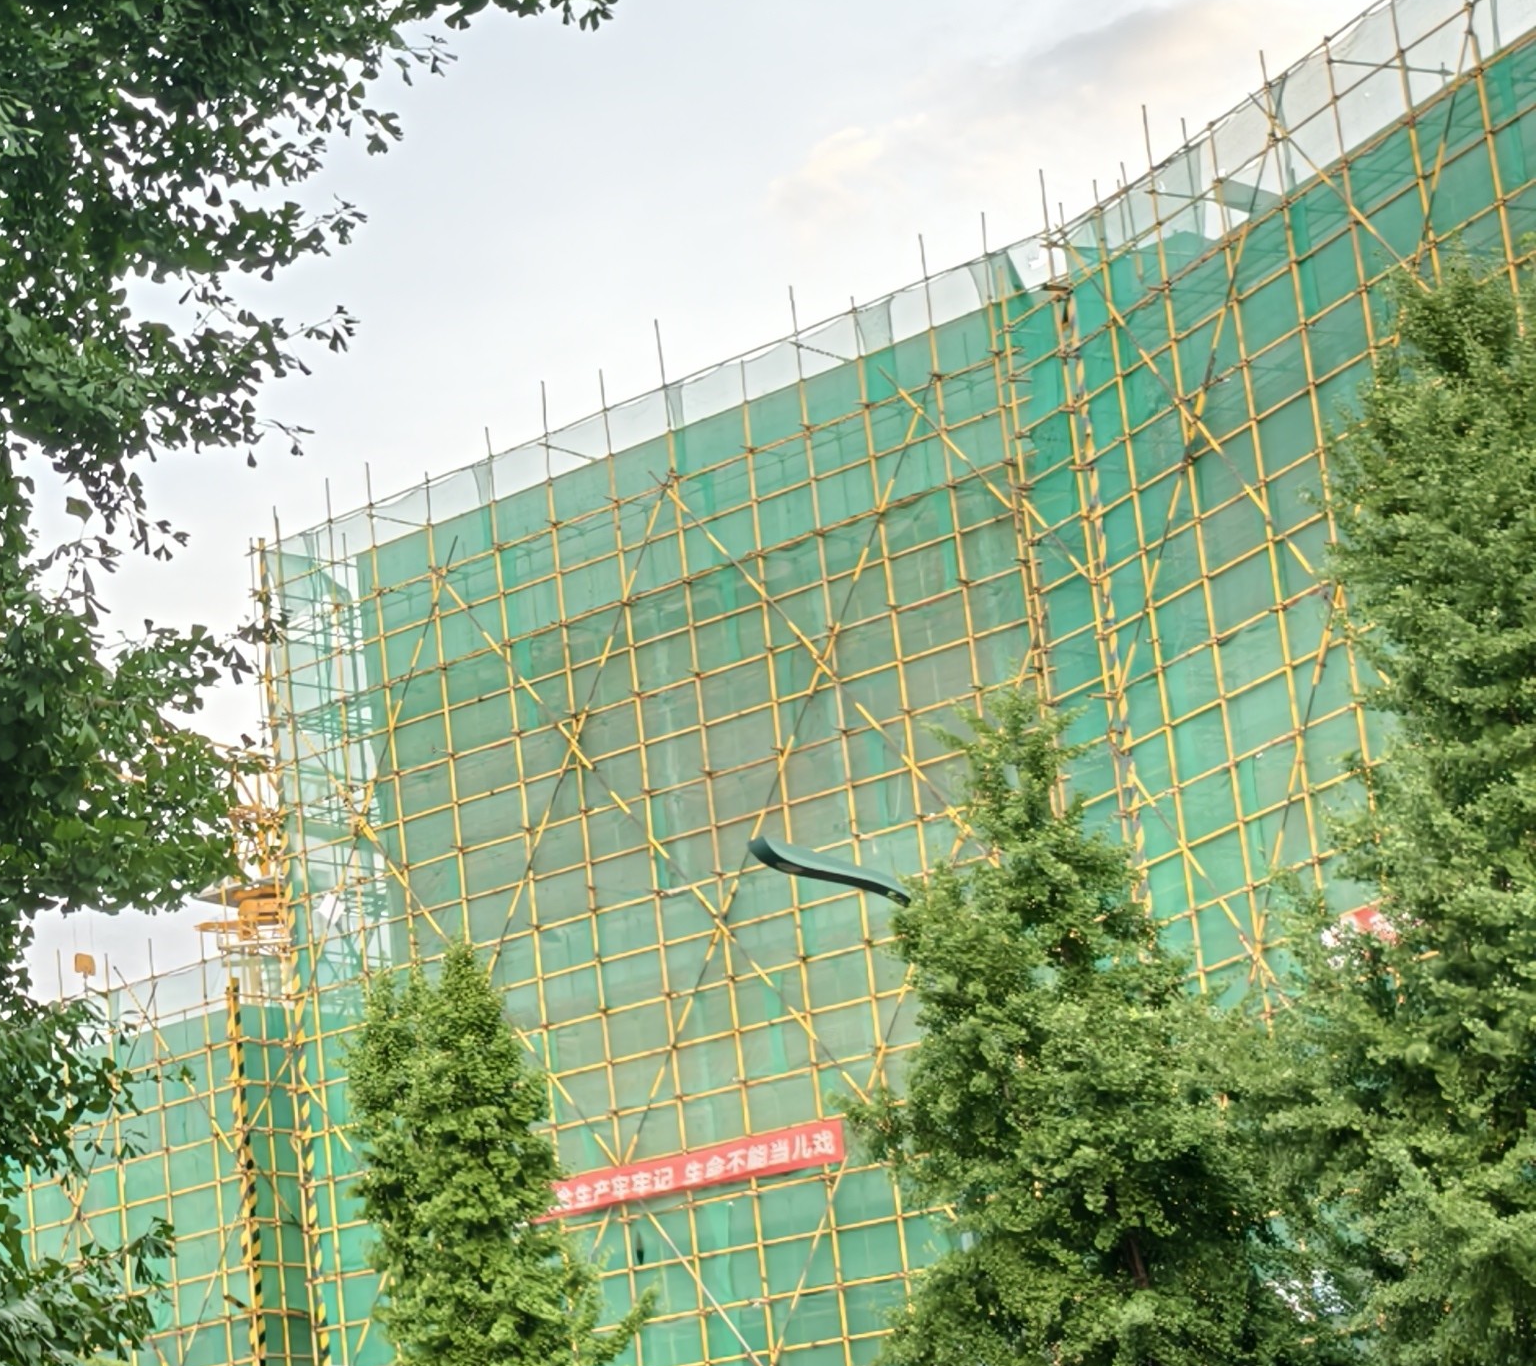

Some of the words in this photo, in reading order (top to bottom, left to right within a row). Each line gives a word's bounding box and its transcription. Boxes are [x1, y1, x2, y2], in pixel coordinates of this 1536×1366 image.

[548, 1166, 674, 1214] 全生产牢牢记
[681, 1130, 836, 1185] 生命不能当儿戏
